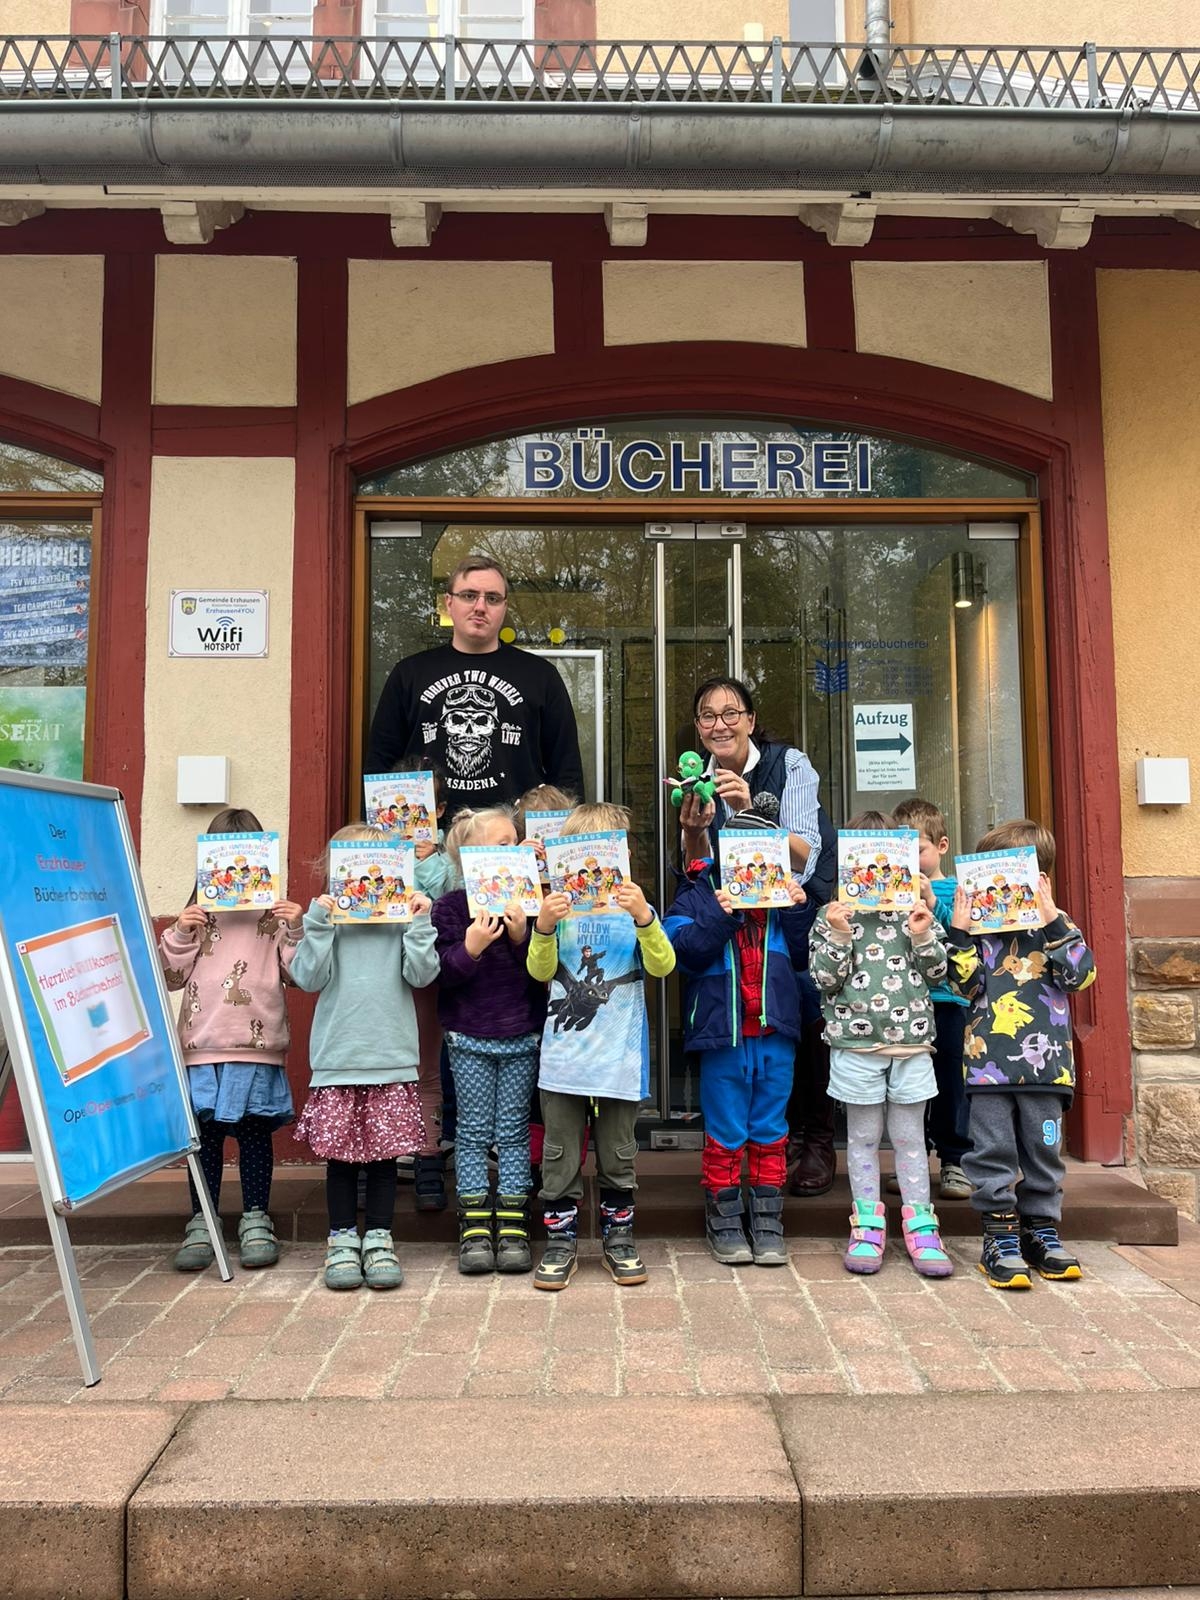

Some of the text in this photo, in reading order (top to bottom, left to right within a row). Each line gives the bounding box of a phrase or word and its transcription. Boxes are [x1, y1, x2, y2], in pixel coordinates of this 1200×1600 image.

[523, 428, 872, 492] BÜCHEREI
[197, 626, 243, 643] Wifi
[204, 642, 241, 651] HOTSPOT
[420, 670, 524, 707] FOREVER TWO WHEELS
[855, 711, 908, 728] Aufzug
[501, 730, 521, 746] LIVE
[444, 776, 498, 791] ASADENA
[48, 823, 67, 839] Der
[551, 833, 601, 845] LESEMAUS
[578, 921, 610, 934] FOLLOW
[577, 934, 610, 946] MY LEAD
[53, 998, 67, 1011] im
